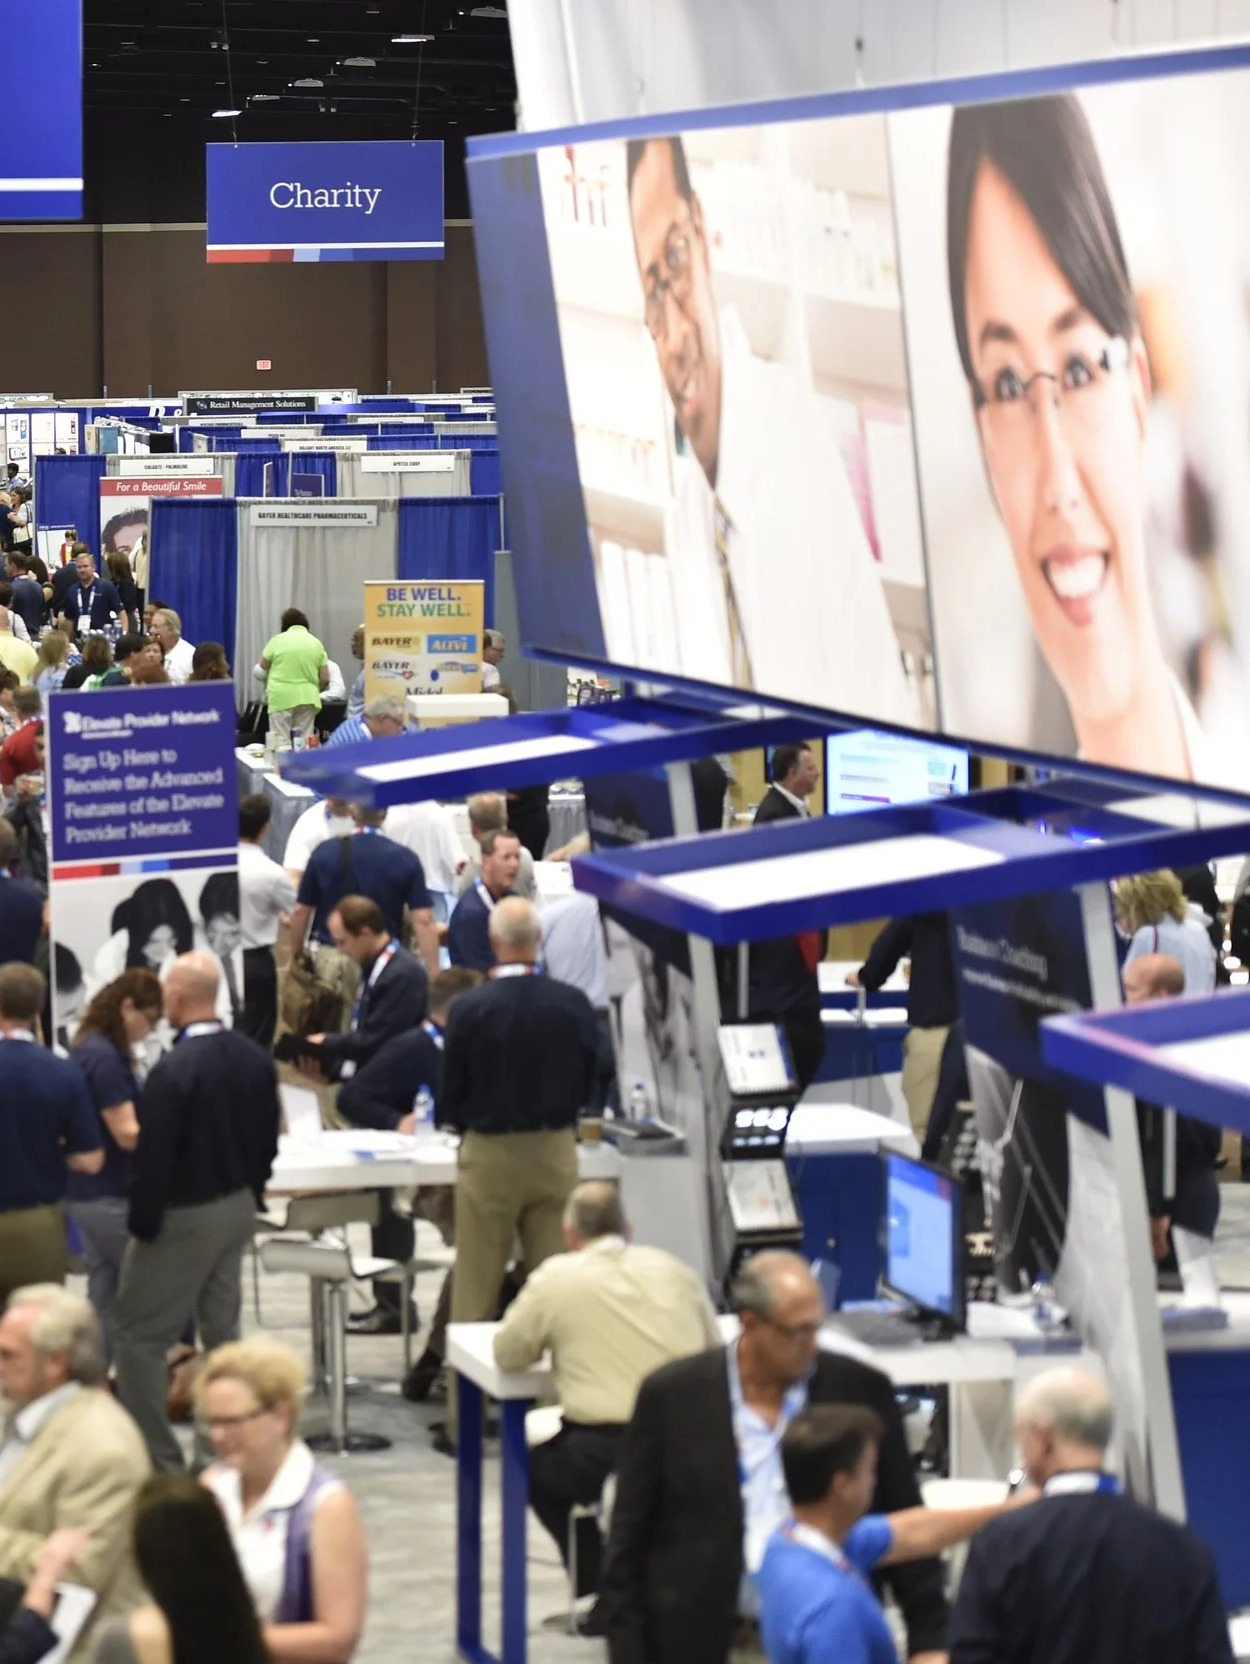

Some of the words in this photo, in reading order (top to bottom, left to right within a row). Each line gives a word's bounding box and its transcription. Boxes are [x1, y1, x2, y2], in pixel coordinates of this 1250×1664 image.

[269, 181, 382, 214] Charity
[210, 401, 230, 409] Retail
[232, 401, 274, 409] Management
[276, 400, 306, 408] Solutions
[116, 483, 130, 492] For
[142, 482, 180, 492] Beautiful
[183, 482, 206, 490] Smile
[387, 588, 406, 601] BE
[412, 588, 461, 600] WELL.
[377, 604, 416, 617] STAY
[420, 604, 470, 616] WELL.
[372, 637, 411, 646] BAYER
[372, 662, 410, 670] BAYER
[124, 712, 170, 728] Provider
[172, 709, 220, 726] Network
[63, 753, 97, 774] Sign
[98, 751, 120, 771] Up
[123, 749, 159, 766] Here
[162, 748, 177, 764] to
[124, 773, 148, 791] the
[150, 766, 224, 789] Advanced
[64, 802, 126, 820] Features
[129, 798, 145, 815] of
[146, 796, 170, 813] the
[171, 792, 224, 812] Elevate
[65, 825, 128, 845] Provider
[130, 818, 192, 839] Network
